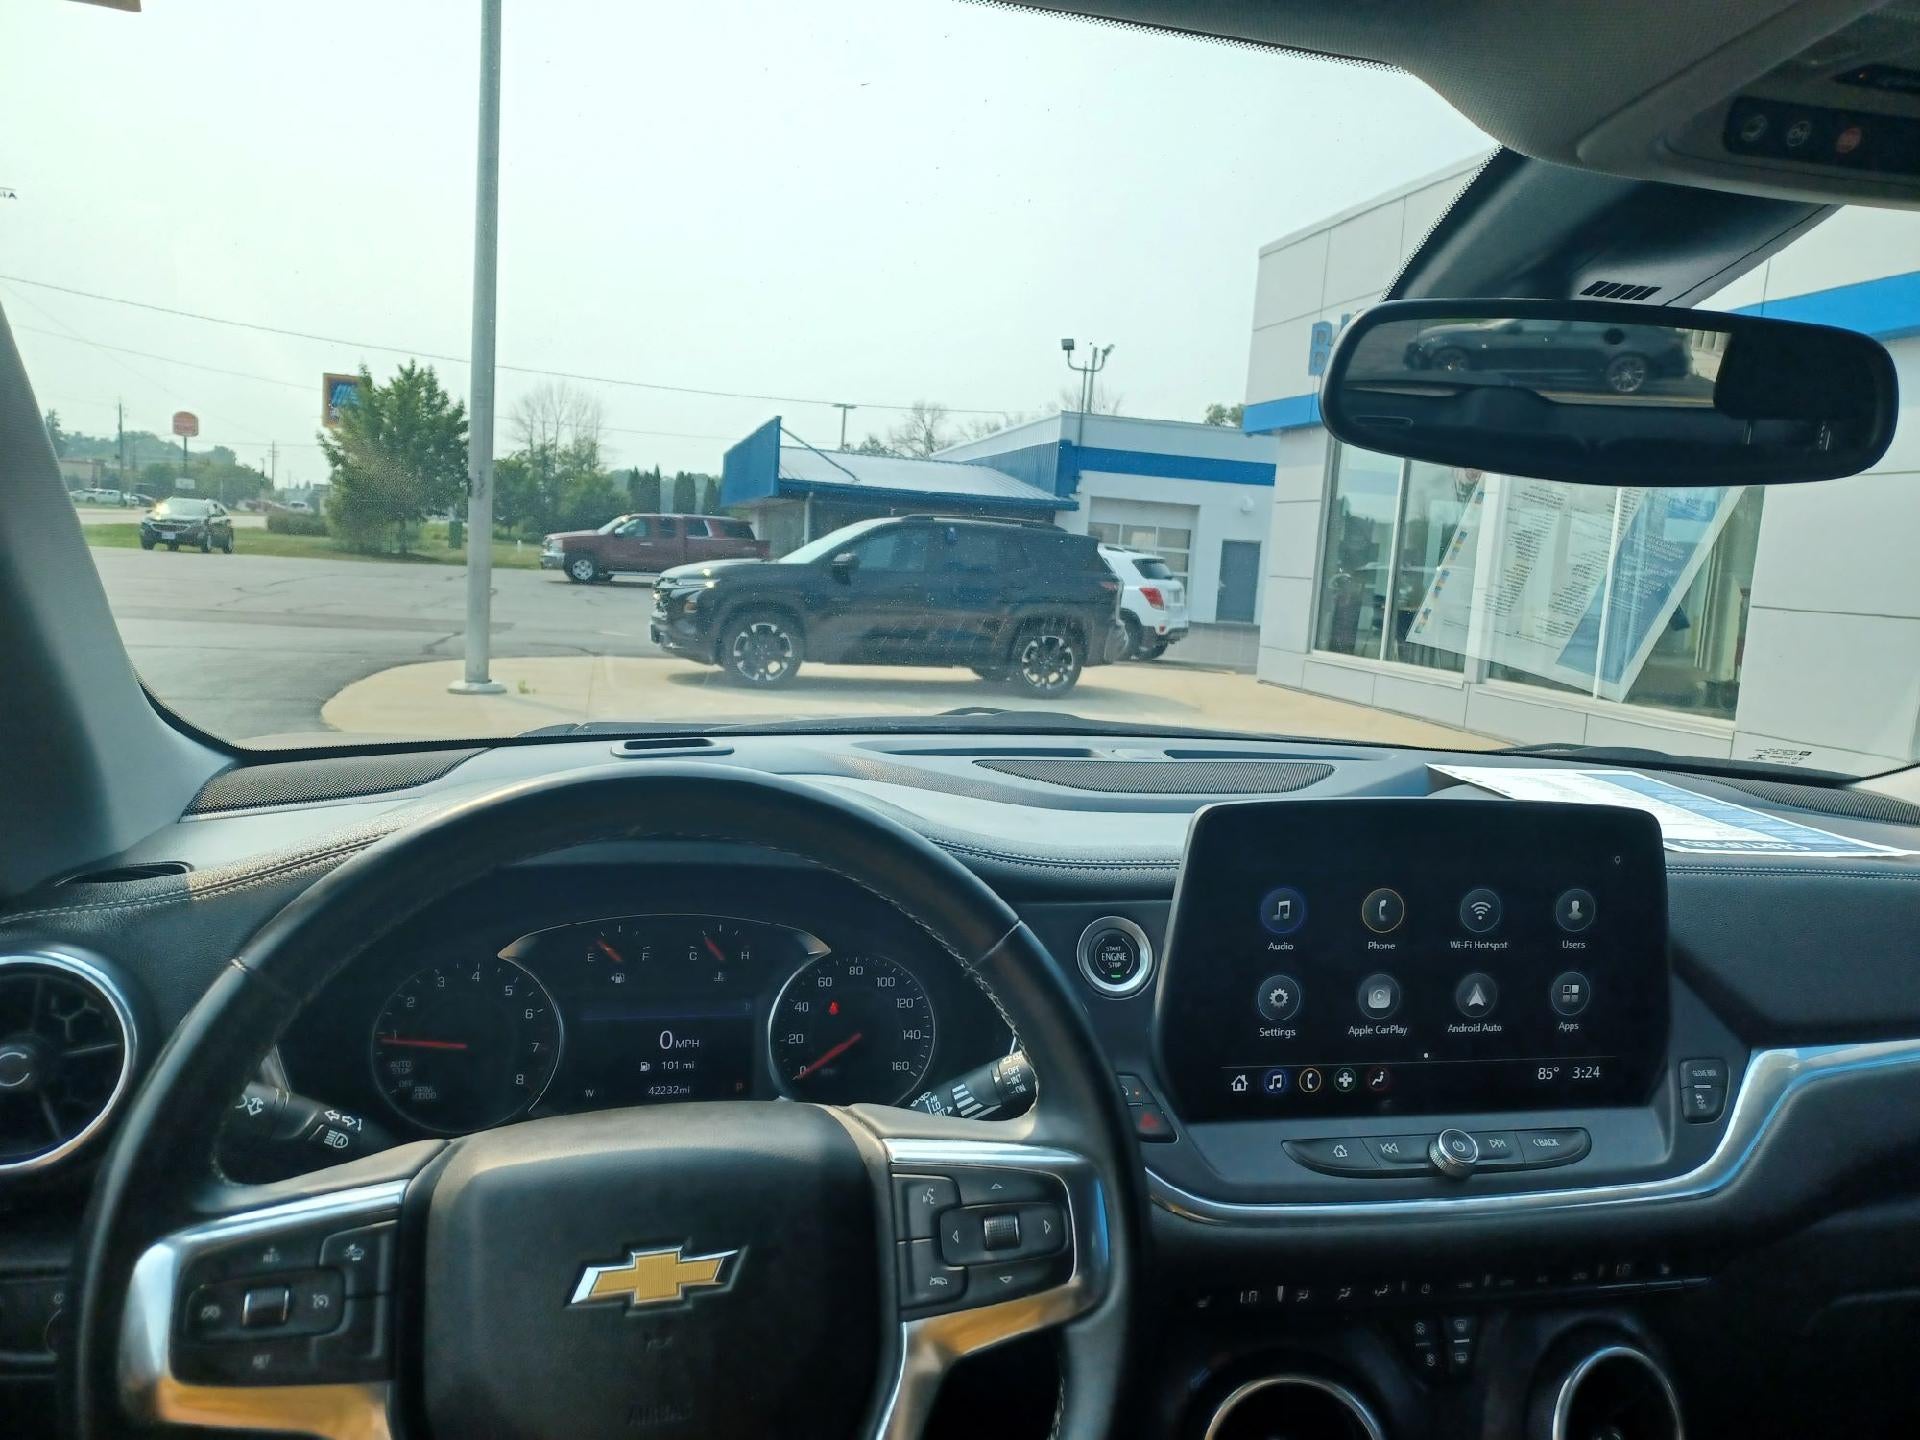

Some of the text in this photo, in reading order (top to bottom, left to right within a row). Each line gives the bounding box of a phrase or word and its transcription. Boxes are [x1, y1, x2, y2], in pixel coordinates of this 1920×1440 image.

[1268, 942, 1294, 950] Audio
[1368, 941, 1396, 950] Phone
[1450, 940, 1508, 950] Wi-Fi Hotspot
[1562, 940, 1586, 949] Users
[587, 953, 595, 962] E
[642, 952, 650, 961] F
[689, 952, 698, 961] C
[741, 951, 750, 960] H
[1101, 952, 1127, 961] ENGINE
[849, 966, 864, 976] 80
[471, 971, 480, 982] 4
[817, 976, 833, 987] 60
[437, 976, 445, 988] 3
[877, 977, 896, 987] 100
[504, 985, 513, 996] 5
[406, 997, 415, 1008] 2
[794, 1001, 809, 1012] 40
[896, 998, 914, 1009] 120
[525, 1009, 534, 1019] 6
[1348, 1025, 1407, 1037] Apple CarPlay
[1447, 1023, 1502, 1033] Android Auto
[1558, 1021, 1579, 1032] Apps
[903, 1030, 921, 1040] 140
[1259, 1027, 1296, 1038] Settings
[659, 1030, 700, 1050] 0 MPH
[788, 1034, 804, 1044] 20
[532, 1042, 540, 1053] 7
[661, 1060, 695, 1070] 101 mi
[891, 1061, 910, 1071] 160
[1538, 1065, 1600, 1080] 85° 3:24
[515, 1074, 524, 1085] 8
[584, 1089, 595, 1097] W
[1015, 1083, 1027, 1094] ON
[931, 1101, 941, 1111] LO
